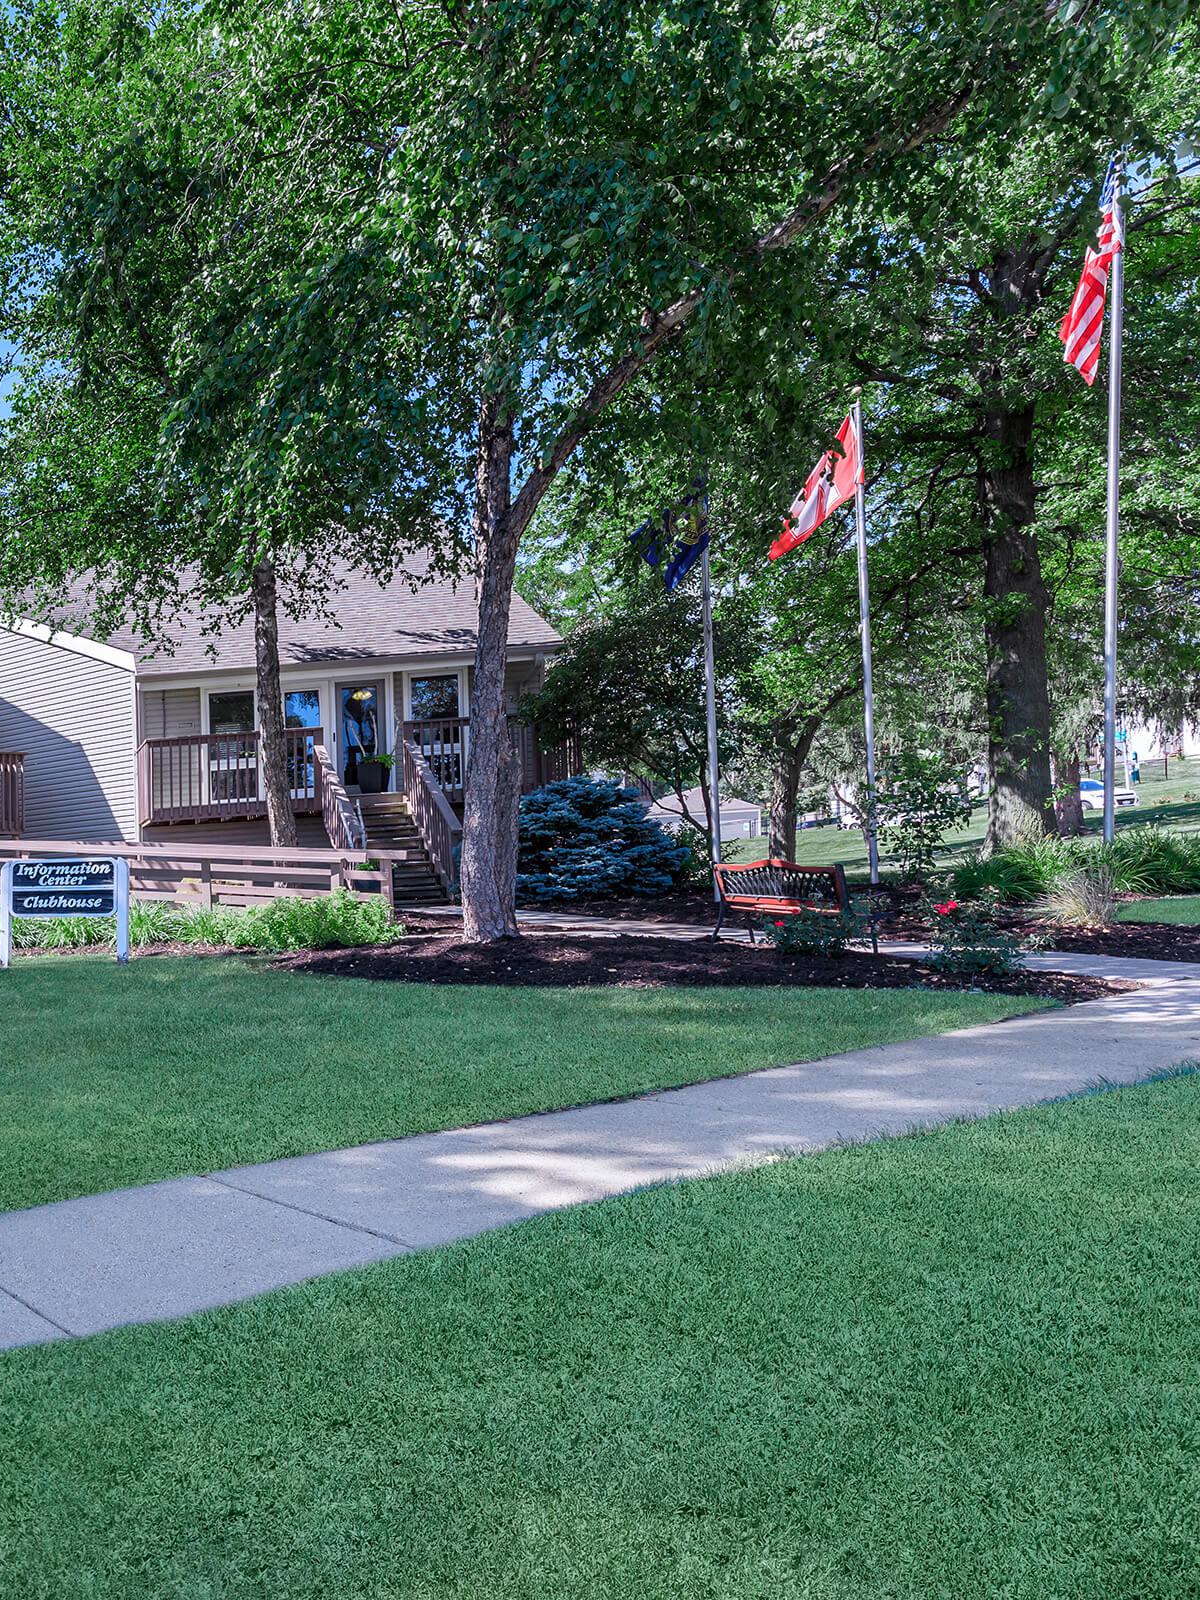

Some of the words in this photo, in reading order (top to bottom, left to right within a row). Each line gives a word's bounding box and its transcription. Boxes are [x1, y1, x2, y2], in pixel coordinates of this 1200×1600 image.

[16, 862, 111, 879] Information
[38, 874, 87, 886] Center
[23, 895, 102, 908] Clubhouse
